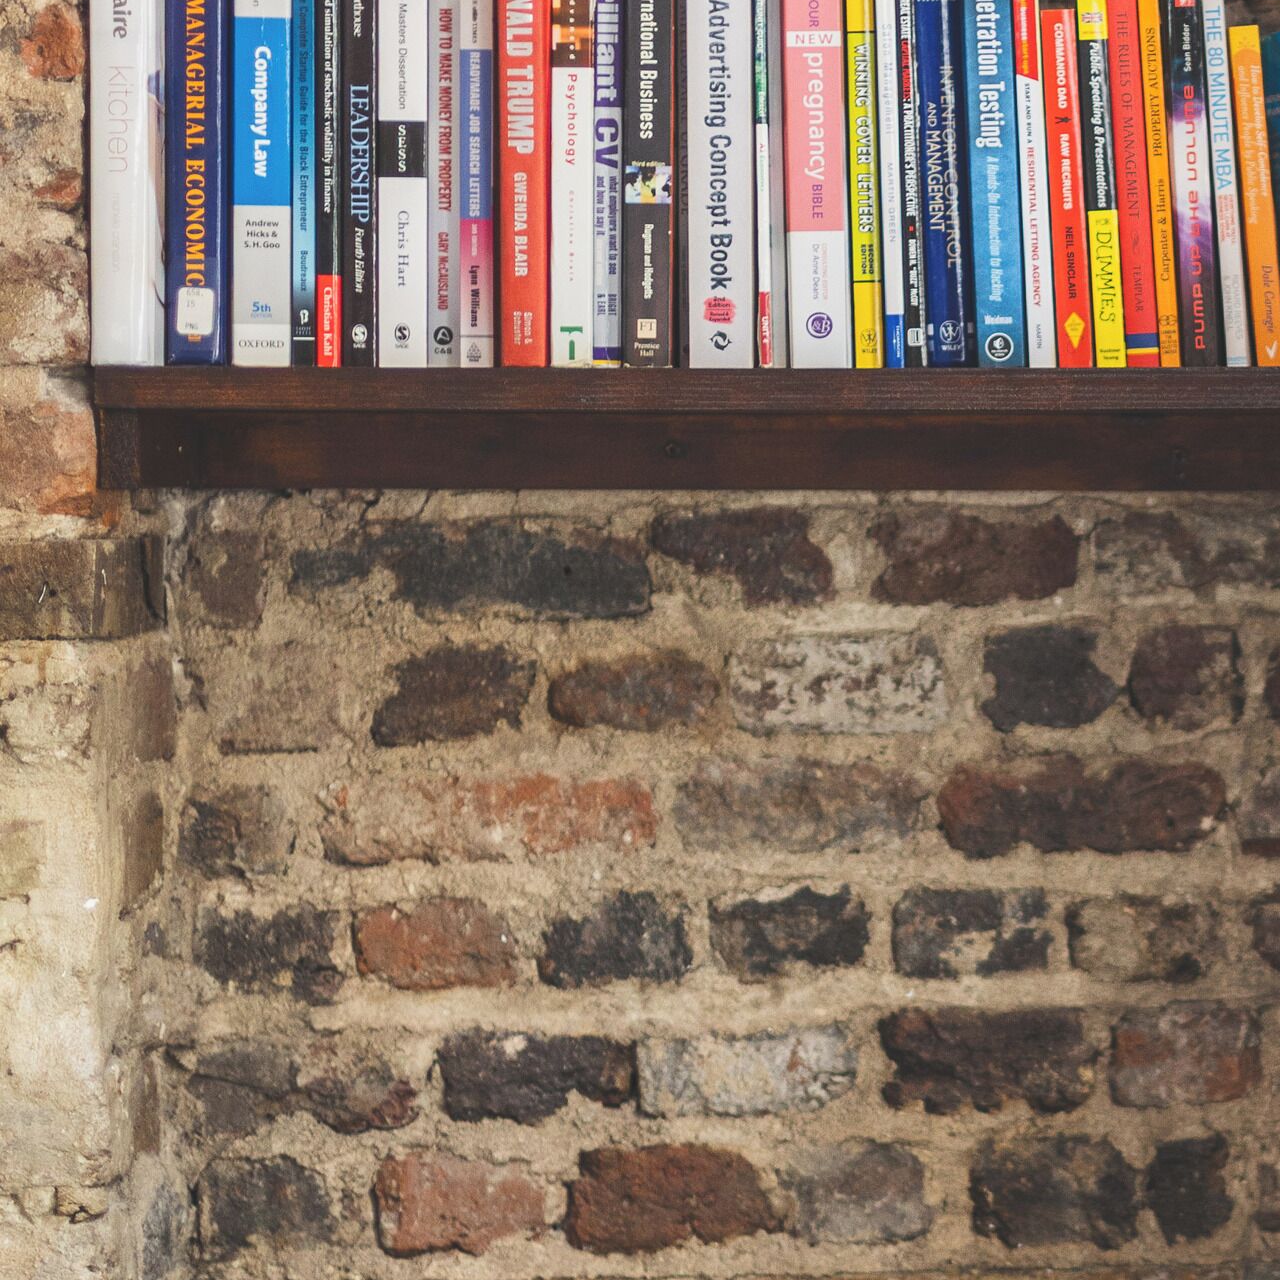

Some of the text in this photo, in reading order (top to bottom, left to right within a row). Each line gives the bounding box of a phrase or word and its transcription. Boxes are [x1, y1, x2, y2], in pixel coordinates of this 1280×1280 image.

[297, 6, 309, 48] Complete
[324, 9, 333, 58] simulation
[795, 34, 833, 44] NEW
[1182, 23, 1192, 72] Sean Bidder
[1205, 5, 1222, 43] THE
[298, 51, 309, 82] Startup
[324, 60, 333, 72] of
[1054, 23, 1067, 109] COMMANDO DAD
[1089, 42, 1101, 75] Public
[1208, 48, 1224, 67] 80
[108, 66, 136, 173] kitchen
[250, 46, 272, 177] Company Law
[299, 86, 309, 111] Guide
[299, 113, 309, 127] for
[324, 73, 333, 120] stochastic
[438, 8, 452, 212] HOW TO MAKE MONEY FROM PROPERTY
[507, 65, 535, 154] TRUMP
[565, 73, 577, 165] Psychology
[640, 69, 657, 140] Business
[803, 52, 825, 181] pregnancy
[976, 80, 1005, 148] Testing
[1090, 75, 1103, 125] Speaking
[1115, 12, 1140, 219] THE RULES OF MANAGEMENT
[1145, 27, 1163, 157] PROPERTY AUCTIONS
[1209, 74, 1230, 143] MINUTE
[299, 129, 309, 143] the
[299, 146, 309, 171] Black
[322, 121, 333, 163] volatility
[350, 84, 369, 222] LEADERSHIP
[469, 52, 481, 217] READYMADE JOB SEARCH LETTERS
[595, 117, 619, 169] CV
[854, 42, 873, 233] WINNING COVER LETTERS
[1094, 125, 1105, 135] &
[324, 166, 333, 175] in
[324, 178, 333, 213] finance
[707, 134, 732, 227] Concept
[926, 101, 945, 232] AND MANAGEMENT
[939, 65, 961, 268] INVENTORY CONTROL
[1060, 133, 1072, 210] RAW RECRUITS
[1094, 136, 1108, 208] Presentations
[1214, 149, 1232, 190] MBA
[185, 159, 205, 288] ECONOMIC
[297, 174, 309, 232] Entrepreneur
[514, 172, 528, 276] GWENDA BLAIR
[812, 184, 823, 219] BIBLE
[887, 162, 896, 243] MARTIN GREEN
[299, 250, 309, 292] Boudreaux
[354, 227, 365, 294] Fourth Edition
[397, 210, 410, 288] Chris Hart
[438, 232, 448, 310] GARY McCAUSLAND
[710, 233, 732, 290] Book
[1065, 226, 1076, 299] NEIL SINCLAIR
[1095, 232, 1116, 322] DUMMIES
[253, 302, 271, 312] 5th
[470, 265, 480, 327] Lynn Williams
[608, 294, 616, 316] BRIGHT
[1133, 264, 1144, 313] TEMPLAR
[239, 340, 284, 348] OXFORD
[323, 287, 332, 356] Christian Kahl
